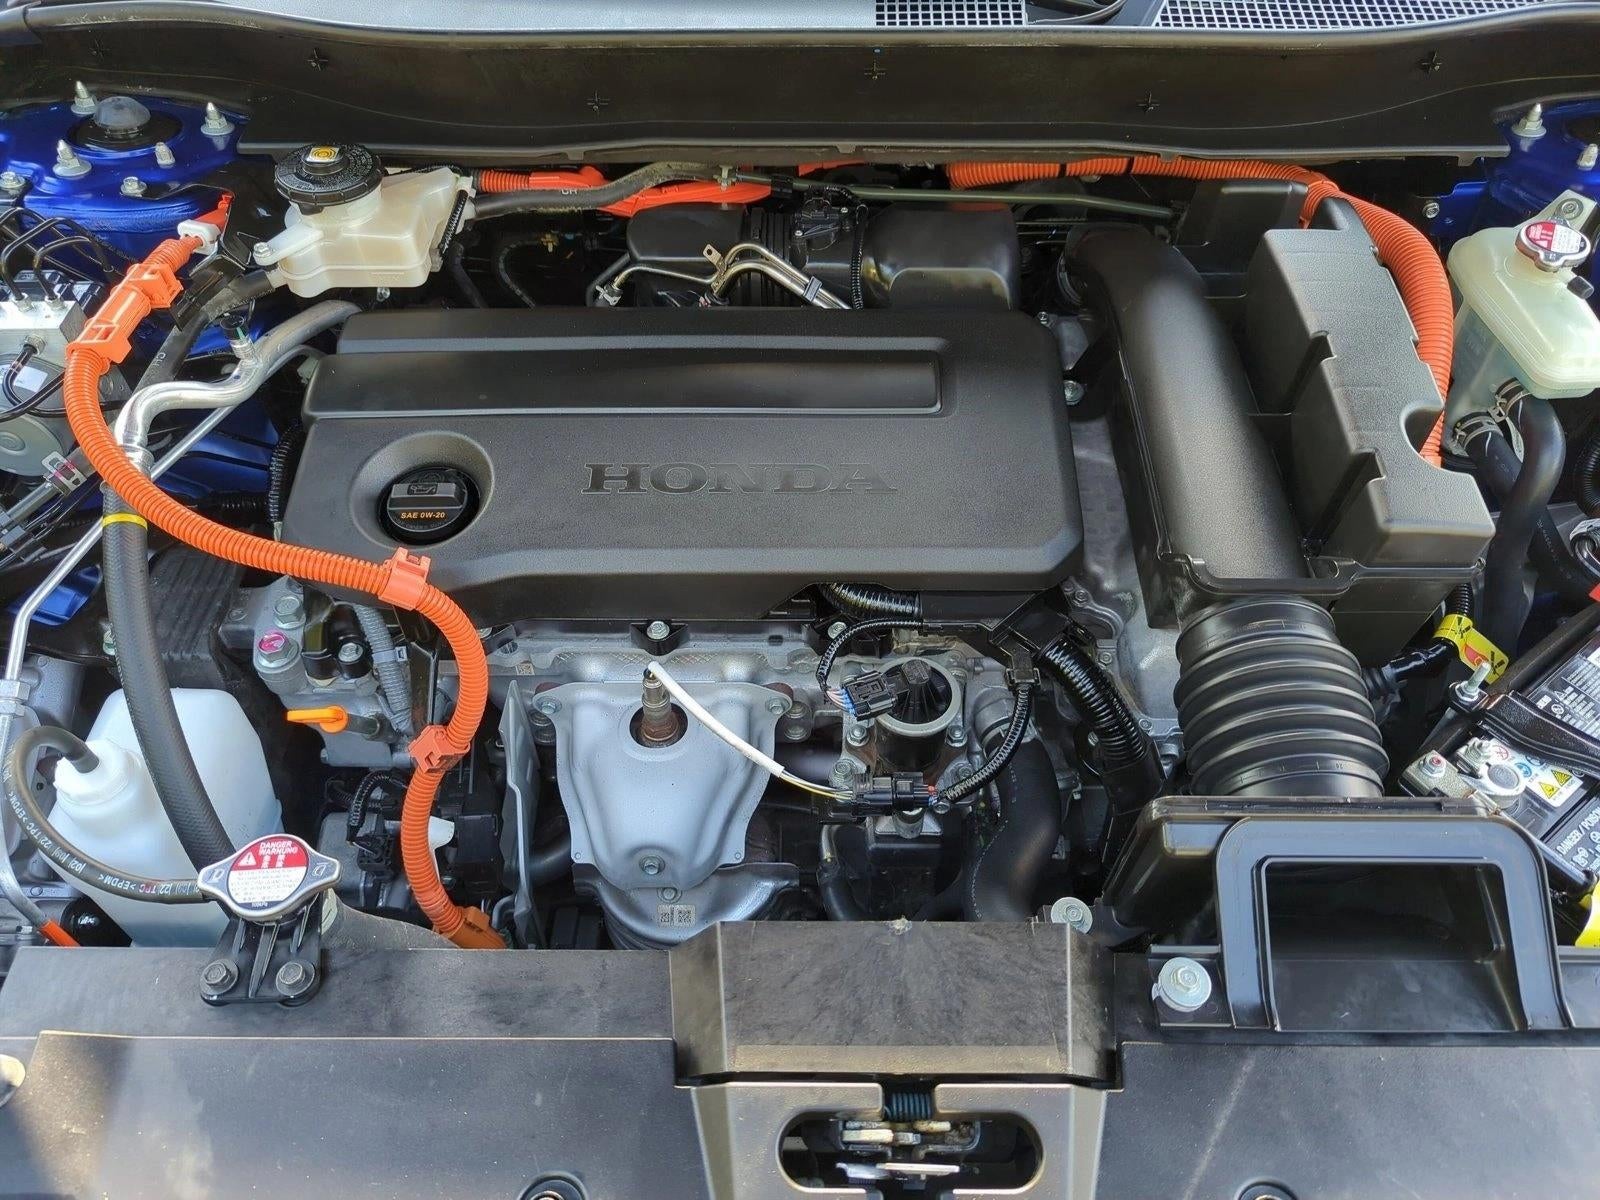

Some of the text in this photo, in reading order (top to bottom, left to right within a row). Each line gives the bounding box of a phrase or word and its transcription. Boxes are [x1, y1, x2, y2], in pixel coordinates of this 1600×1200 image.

[581, 462, 898, 495] HONDA
[1556, 829, 1583, 856] DANGER
[138, 882, 157, 894] TPC
